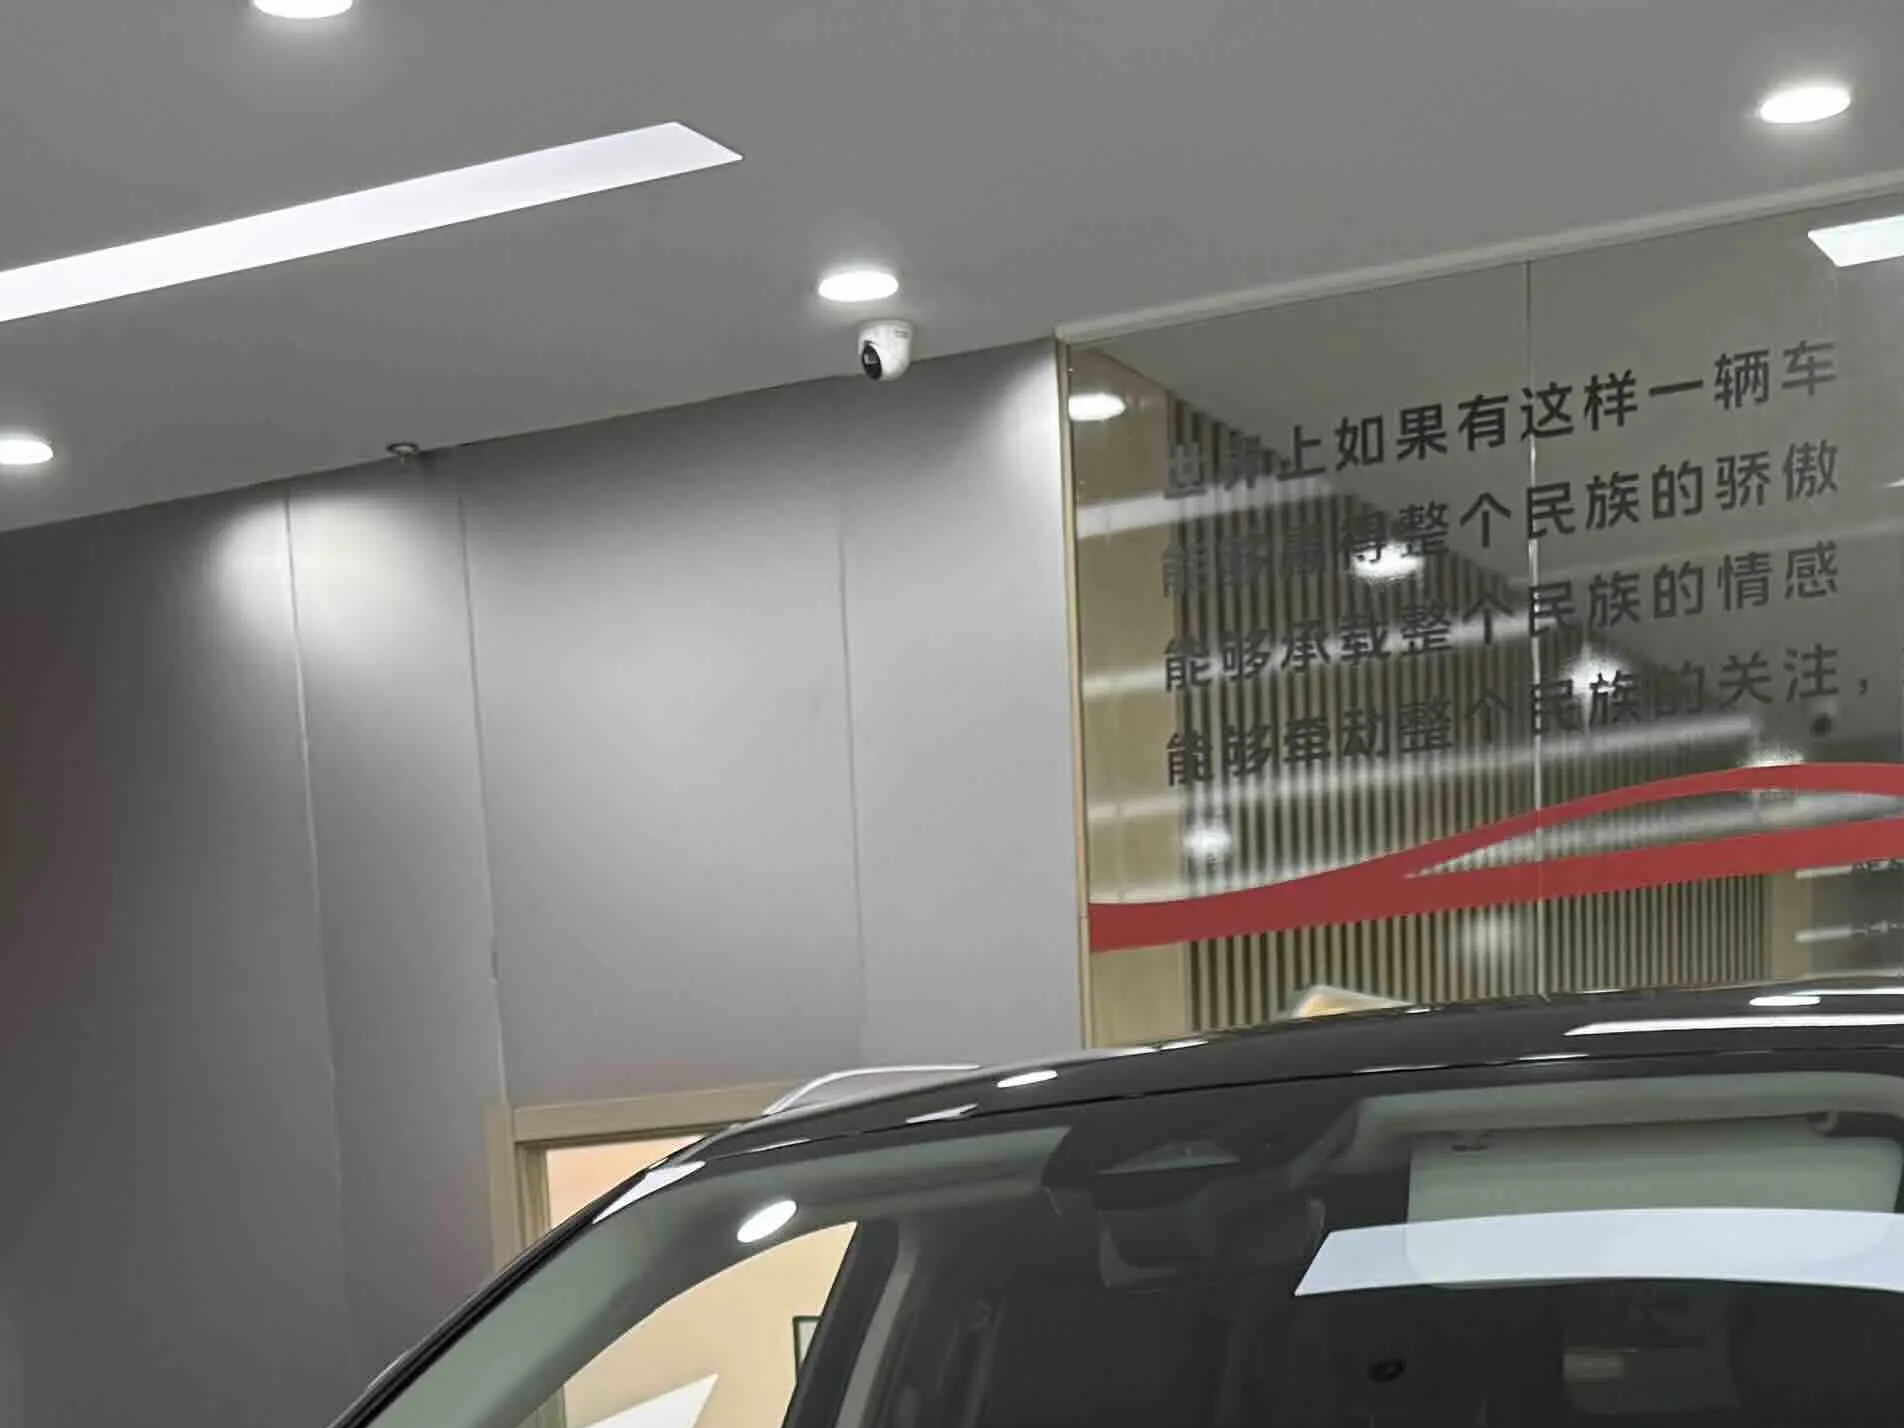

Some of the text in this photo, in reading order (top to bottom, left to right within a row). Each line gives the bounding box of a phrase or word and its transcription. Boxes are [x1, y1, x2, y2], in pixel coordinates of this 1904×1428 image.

[1163, 541, 1840, 693] 能够承载整个民族的情感
